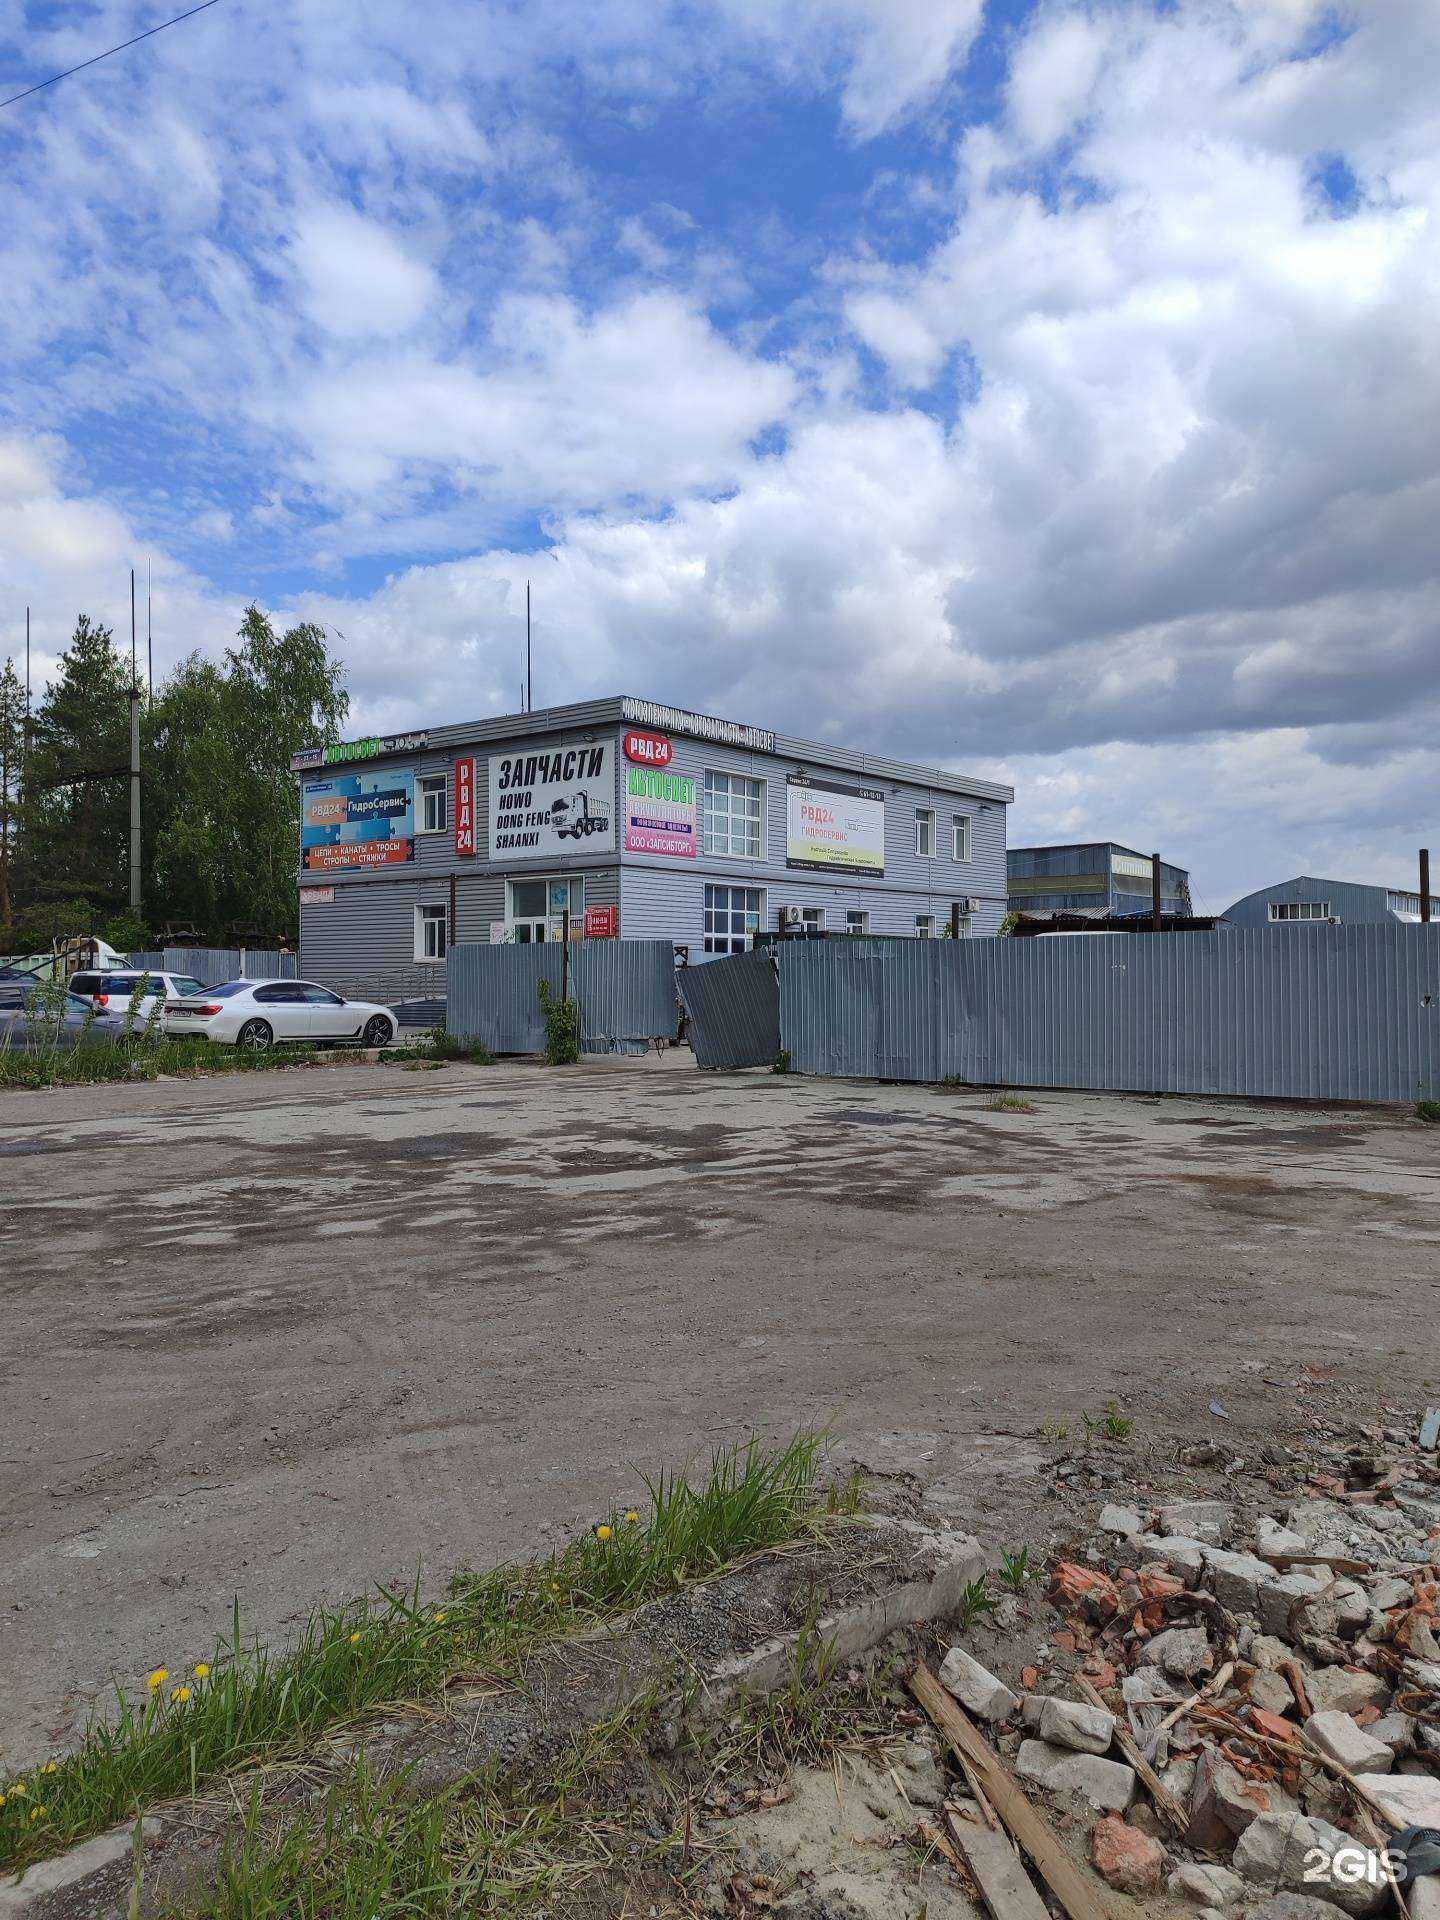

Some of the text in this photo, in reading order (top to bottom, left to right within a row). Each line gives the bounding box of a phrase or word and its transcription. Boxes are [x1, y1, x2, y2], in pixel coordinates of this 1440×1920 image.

[630, 737, 668, 760] РВД 24
[744, 727, 775, 752] АВТОСВЕТ
[498, 747, 604, 790] ЗАПЧАСТИ
[628, 767, 694, 804] АВТОСВЕТ
[312, 797, 405, 817] РВД24 ГидроСервис
[499, 791, 532, 810] HOWO
[496, 811, 551, 829] DONG FENG
[800, 805, 834, 825] РВД24
[457, 829, 471, 849] 24
[496, 832, 540, 850] SHAANXI
[630, 836, 645, 848] ООО
[314, 842, 400, 858] ЦЕПИ КАНАТЫ ТРОСЫ
[323, 853, 387, 866] СТРОПЫ СТЯЖКИ
